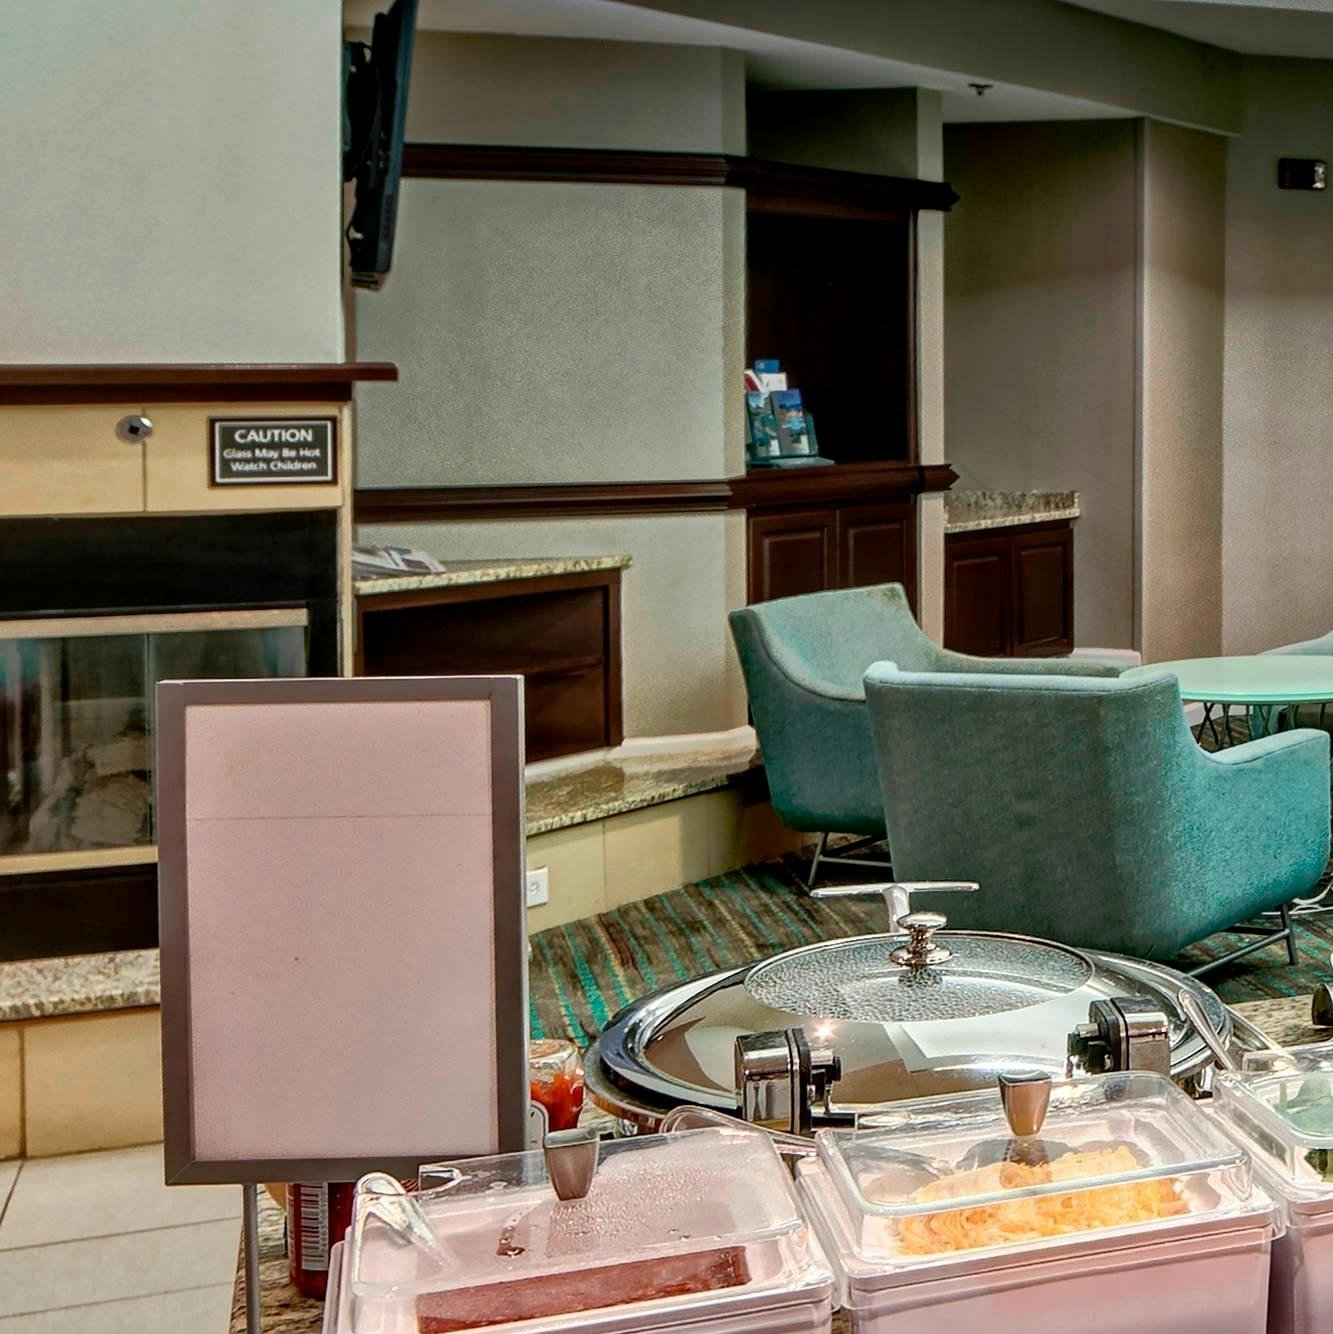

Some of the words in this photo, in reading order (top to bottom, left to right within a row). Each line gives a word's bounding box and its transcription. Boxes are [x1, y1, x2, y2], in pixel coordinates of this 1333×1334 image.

[234, 428, 313, 443] CAUTION
[223, 448, 252, 459] Glass
[254, 448, 279, 460] May
[281, 448, 298, 458] Be
[299, 447, 321, 457] Hot
[231, 461, 267, 471] Watch
[269, 460, 317, 471] Children
